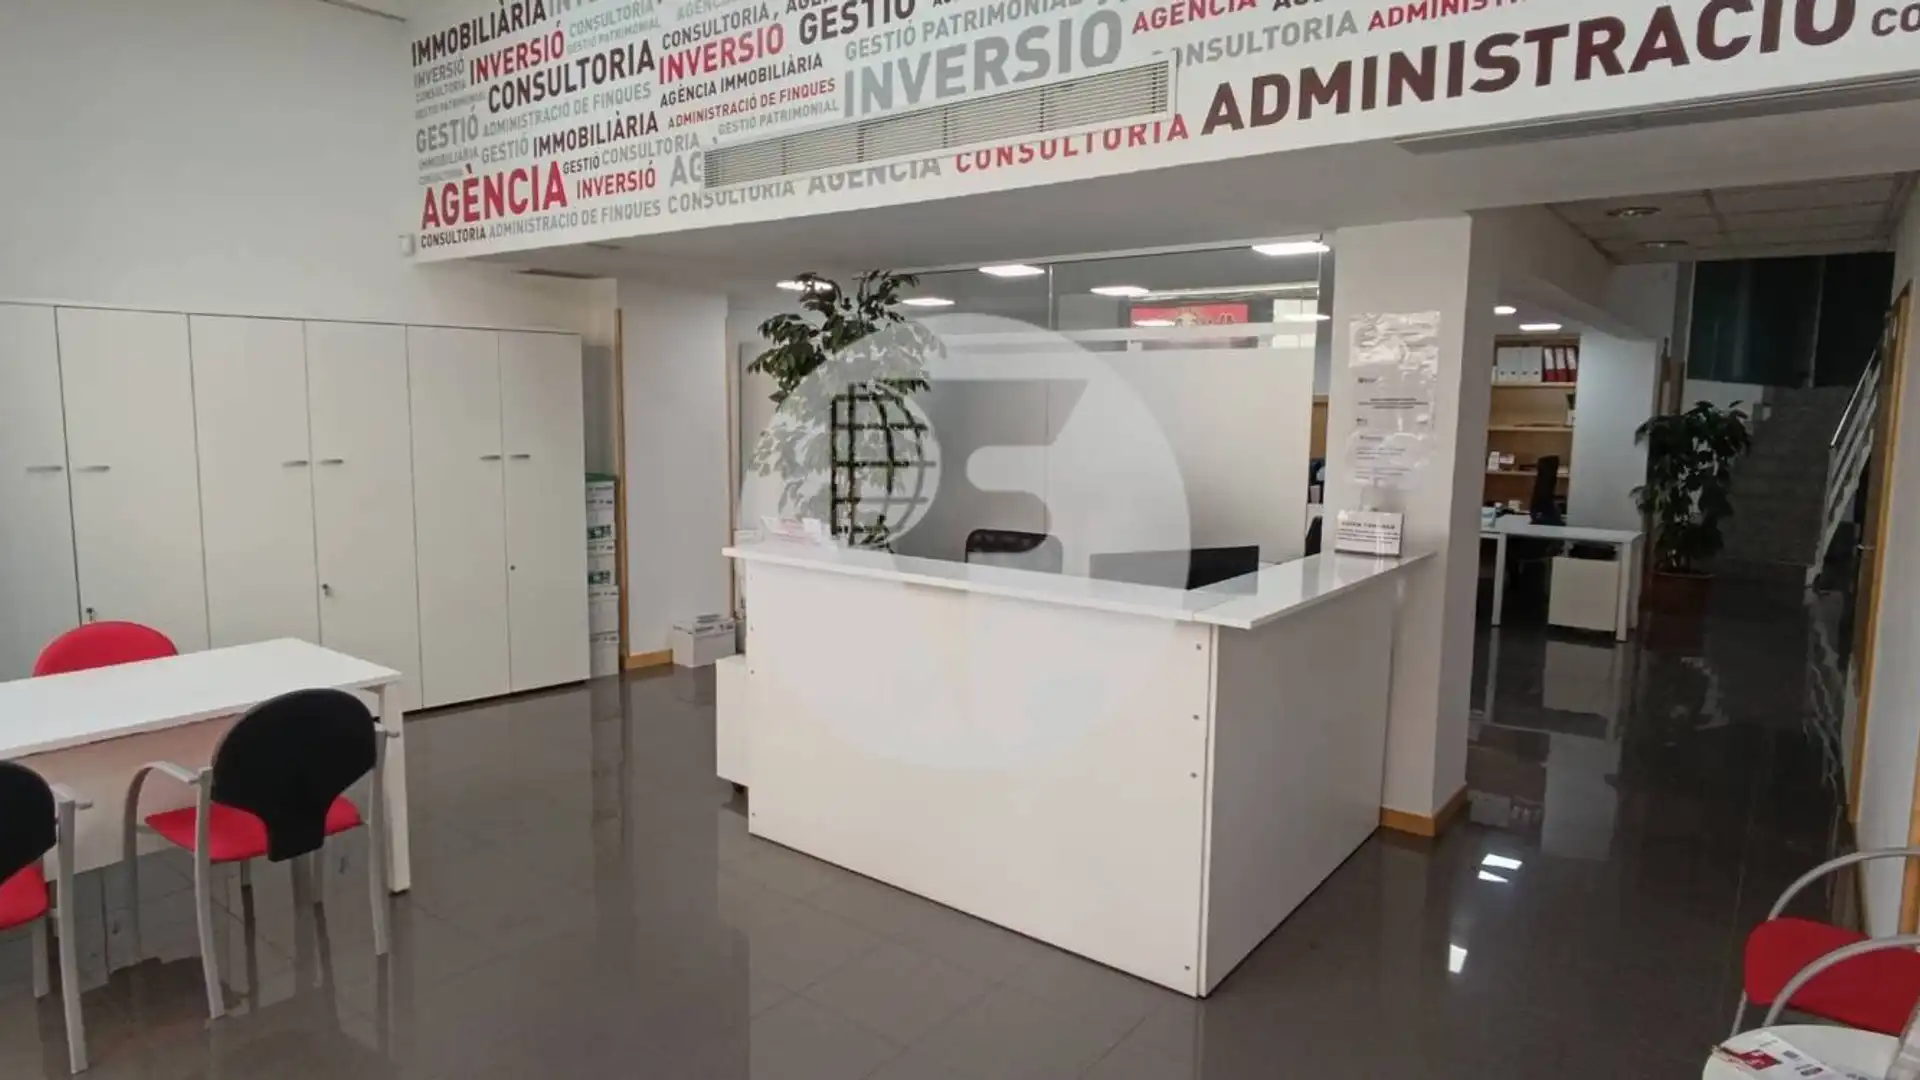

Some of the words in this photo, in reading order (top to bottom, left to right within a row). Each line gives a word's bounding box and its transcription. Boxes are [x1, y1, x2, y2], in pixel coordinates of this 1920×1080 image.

[411, 0, 546, 67] IMMOBILIÀRIA
[569, 0, 654, 38] CONSULTORIA
[845, 20, 916, 61] GESTIÓ
[470, 20, 565, 85] INVERSIÓ
[488, 39, 655, 113] CONSULTORIA
[573, 96, 589, 115] DE
[592, 81, 651, 111] FINQUES
[660, 81, 716, 108] AGÈNCIA
[721, 52, 822, 92] IMMOBILIÀRIA
[760, 93, 776, 108] DE
[779, 78, 836, 103] FINQUES
[416, 104, 479, 153] GESTIÓ
[533, 110, 658, 158] IMMOBILIÀRIA
[760, 99, 840, 128] PATRIMONIAL
[481, 132, 529, 163] GESTIÓ
[602, 132, 700, 165] CONSULTORIA
[955, 113, 1189, 173] CONSULTORIA
[421, 161, 568, 230] AGÈNCIA
[577, 160, 656, 200] INVERSIÓ
[420, 226, 486, 249] CONSULTORIA
[581, 208, 597, 225] DE
[600, 199, 661, 223] FINQUES
